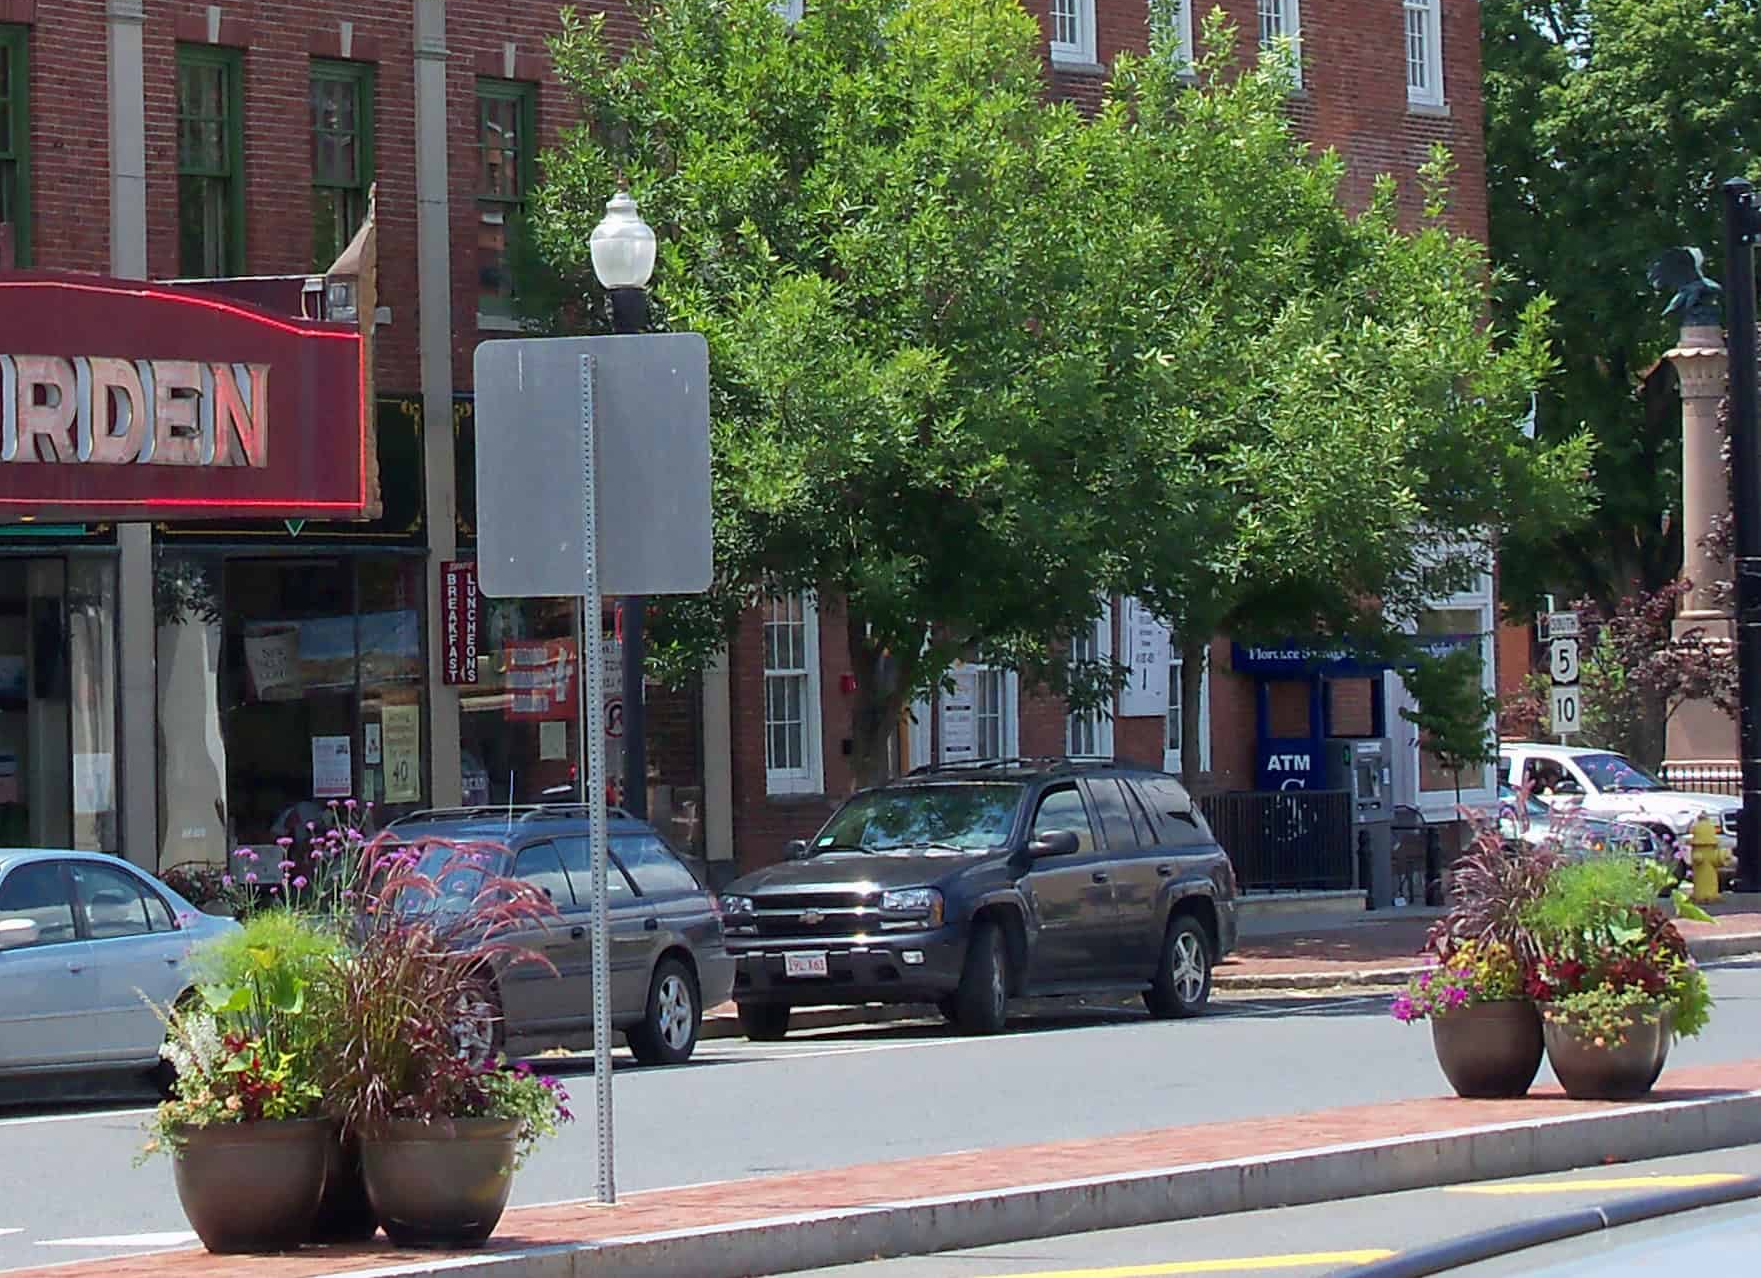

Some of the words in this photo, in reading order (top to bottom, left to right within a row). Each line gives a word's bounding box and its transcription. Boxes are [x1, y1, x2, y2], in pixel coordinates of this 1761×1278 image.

[446, 573, 458, 682] BREAKFAST
[466, 572, 477, 682] LUNCHEONS
[1559, 648, 1570, 673] 5
[1557, 697, 1575, 722] 10
[1267, 754, 1311, 771] ATM
